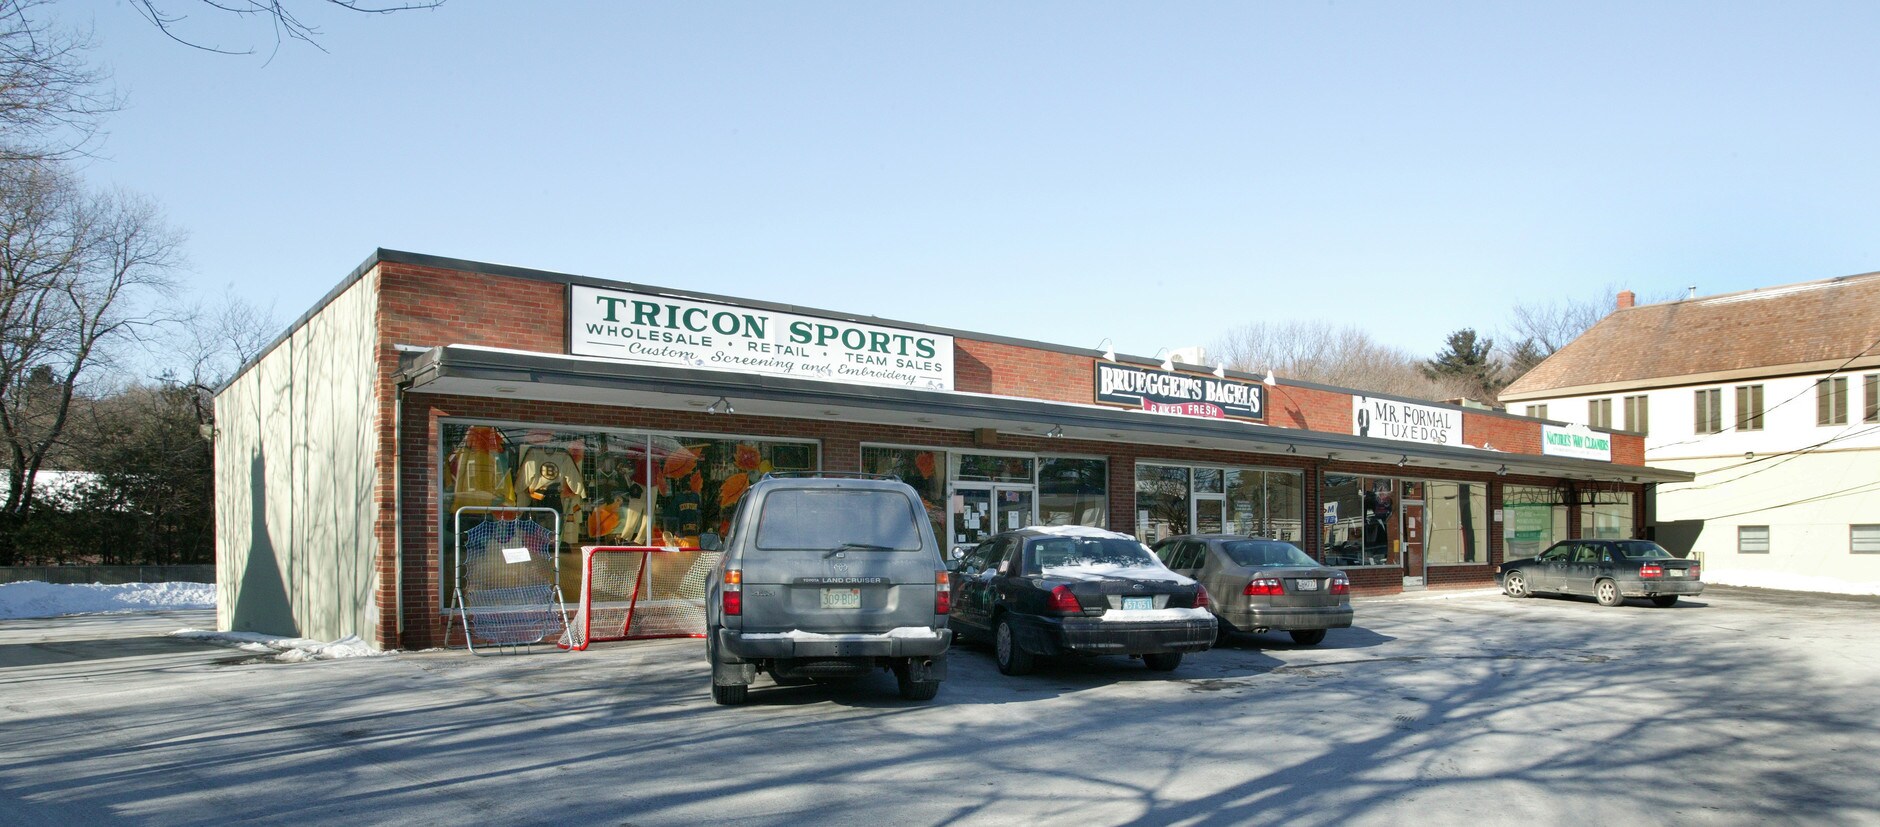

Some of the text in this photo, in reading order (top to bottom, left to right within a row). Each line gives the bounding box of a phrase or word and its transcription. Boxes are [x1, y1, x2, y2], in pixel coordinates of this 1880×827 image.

[586, 323, 942, 372] WHOLESALE RETAIL TEAM SALES
[596, 296, 936, 359] TRICON SPORTS
[628, 342, 916, 385] Custom Screening and Embroidery
[1100, 366, 1260, 413] BRUEGGER'S BAGELS
[1151, 404, 1218, 417] BAKED FRESH
[1375, 402, 1451, 429] MR. FORMAL
[1382, 422, 1447, 443] TUXEDOS
